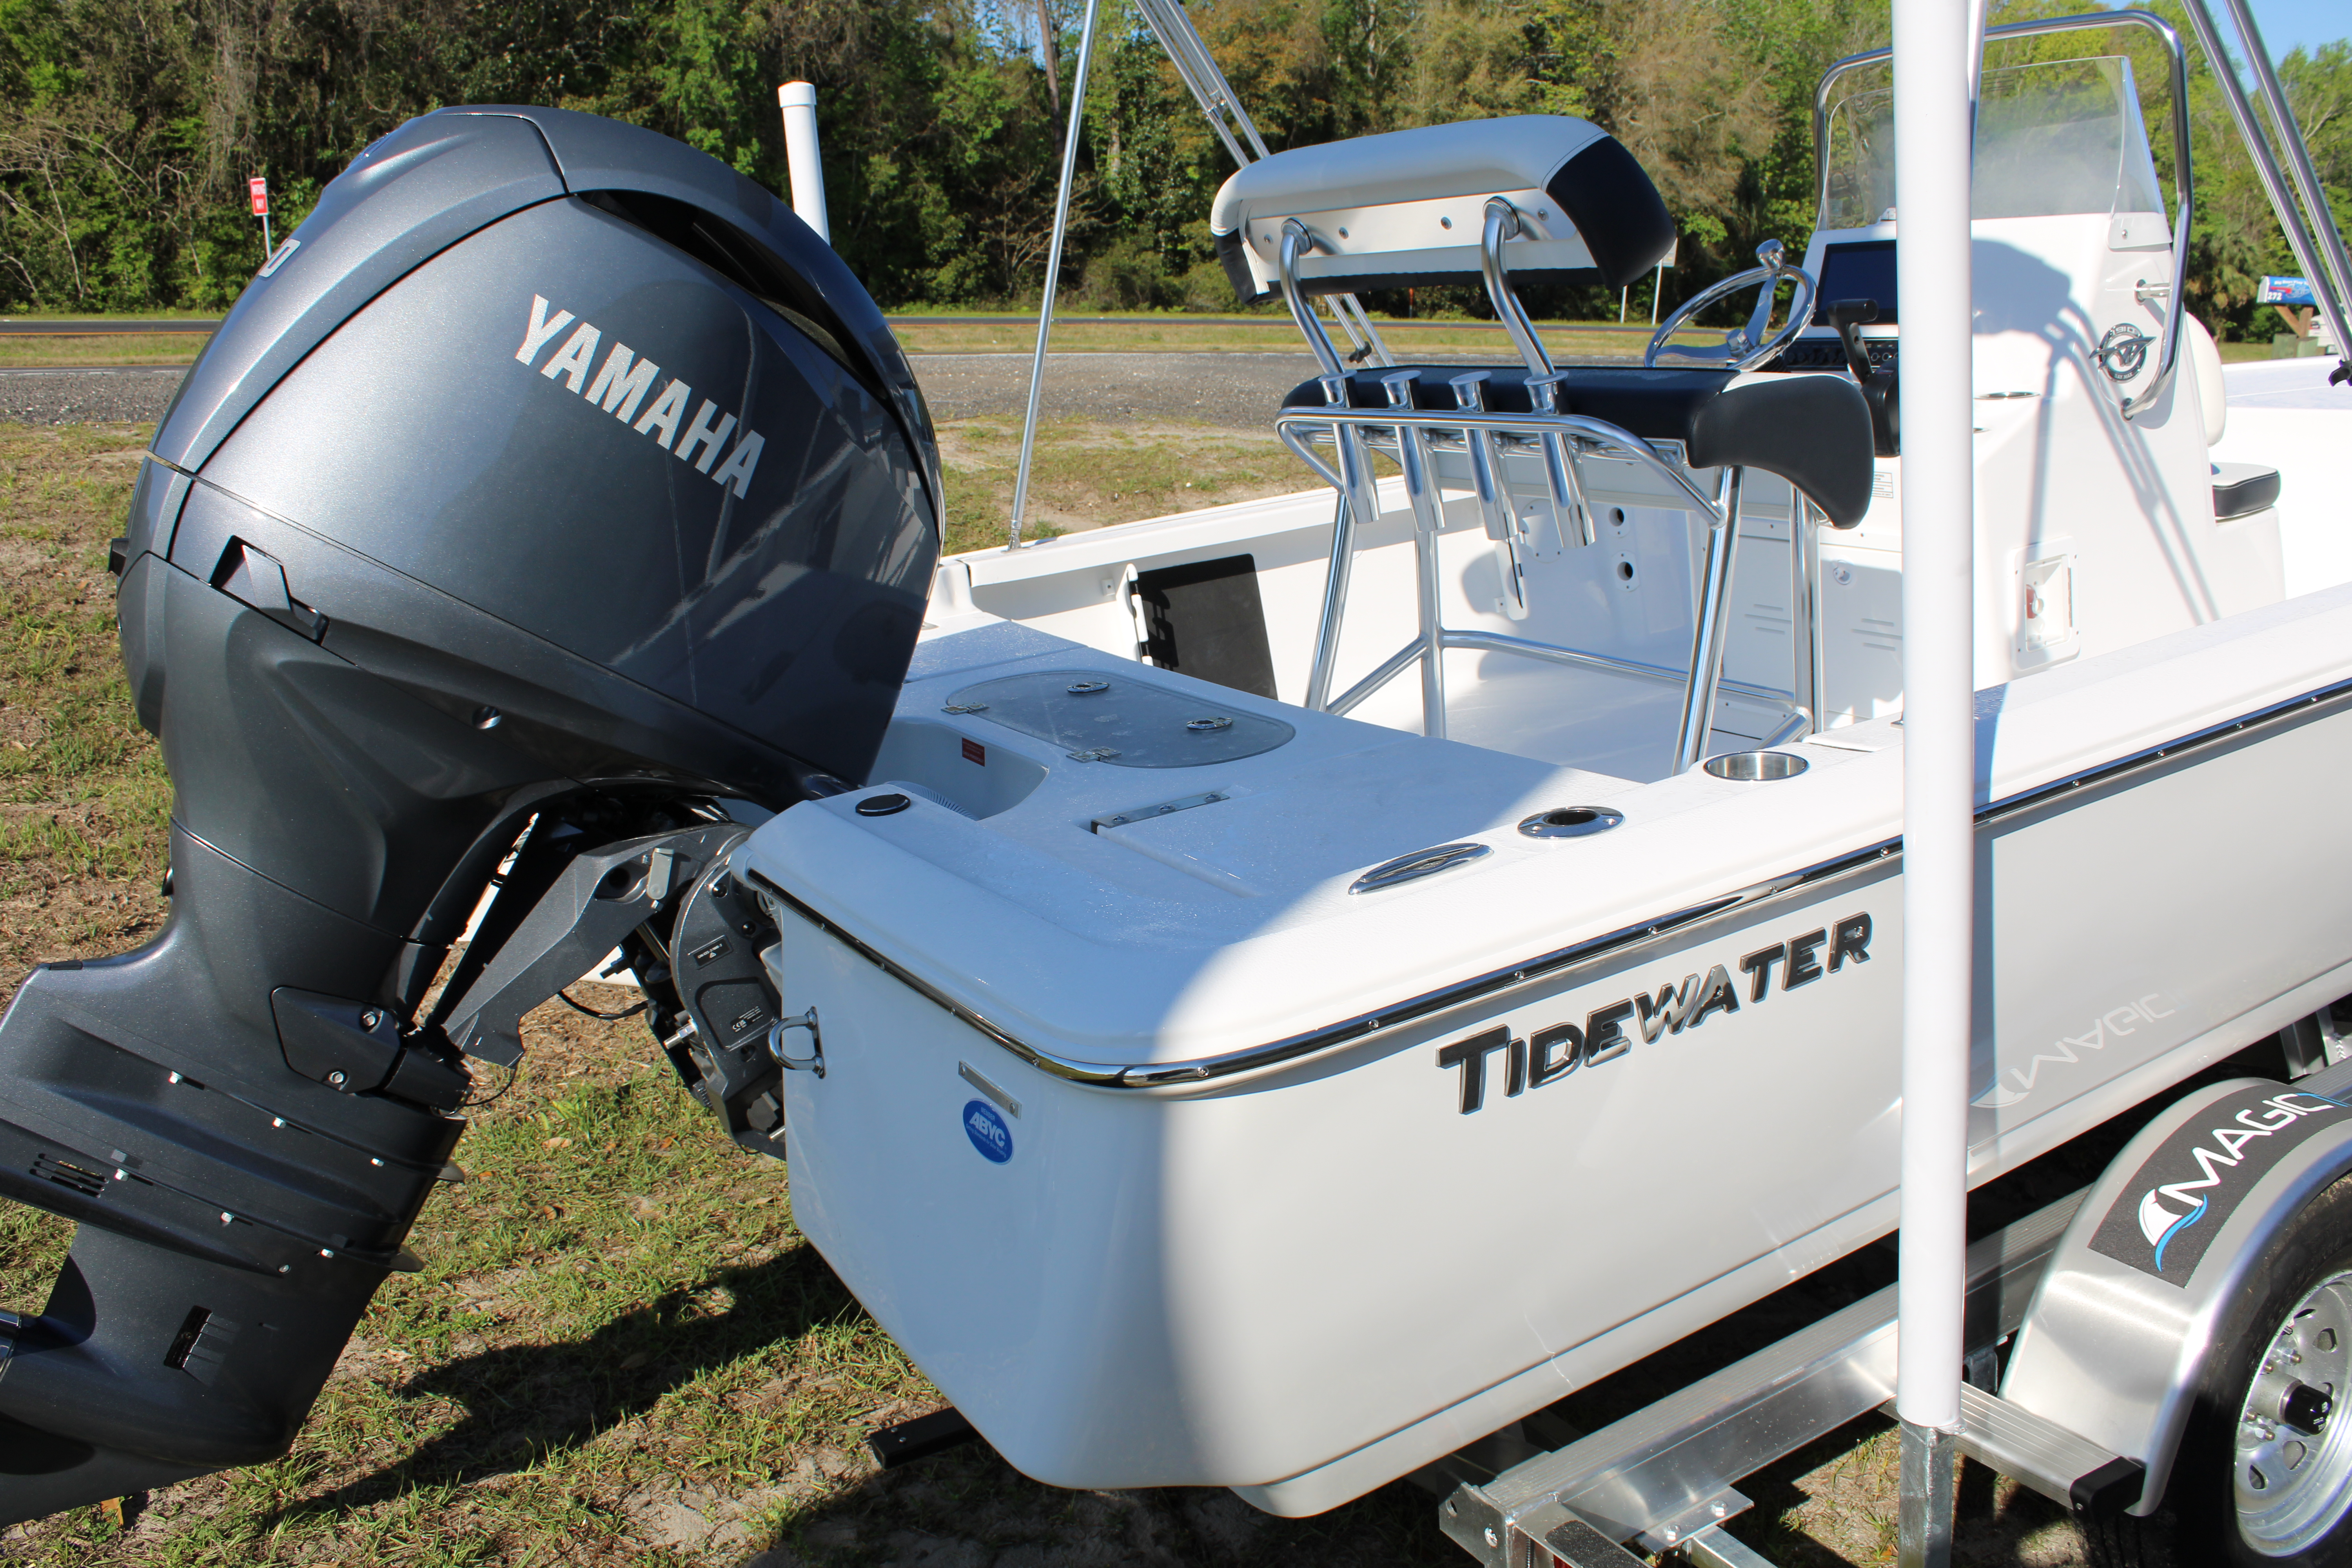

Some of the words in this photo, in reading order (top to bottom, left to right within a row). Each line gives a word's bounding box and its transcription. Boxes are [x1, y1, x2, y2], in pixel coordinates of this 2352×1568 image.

[2268, 292, 2282, 301] 272
[515, 294, 766, 499] YAMAHA
[1435, 911, 1873, 1115] TIDEWATER
[969, 1111, 1005, 1147] ABYC
[981, 1107, 996, 1122] MEMBER
[2158, 1093, 2336, 1207] MAGIC
